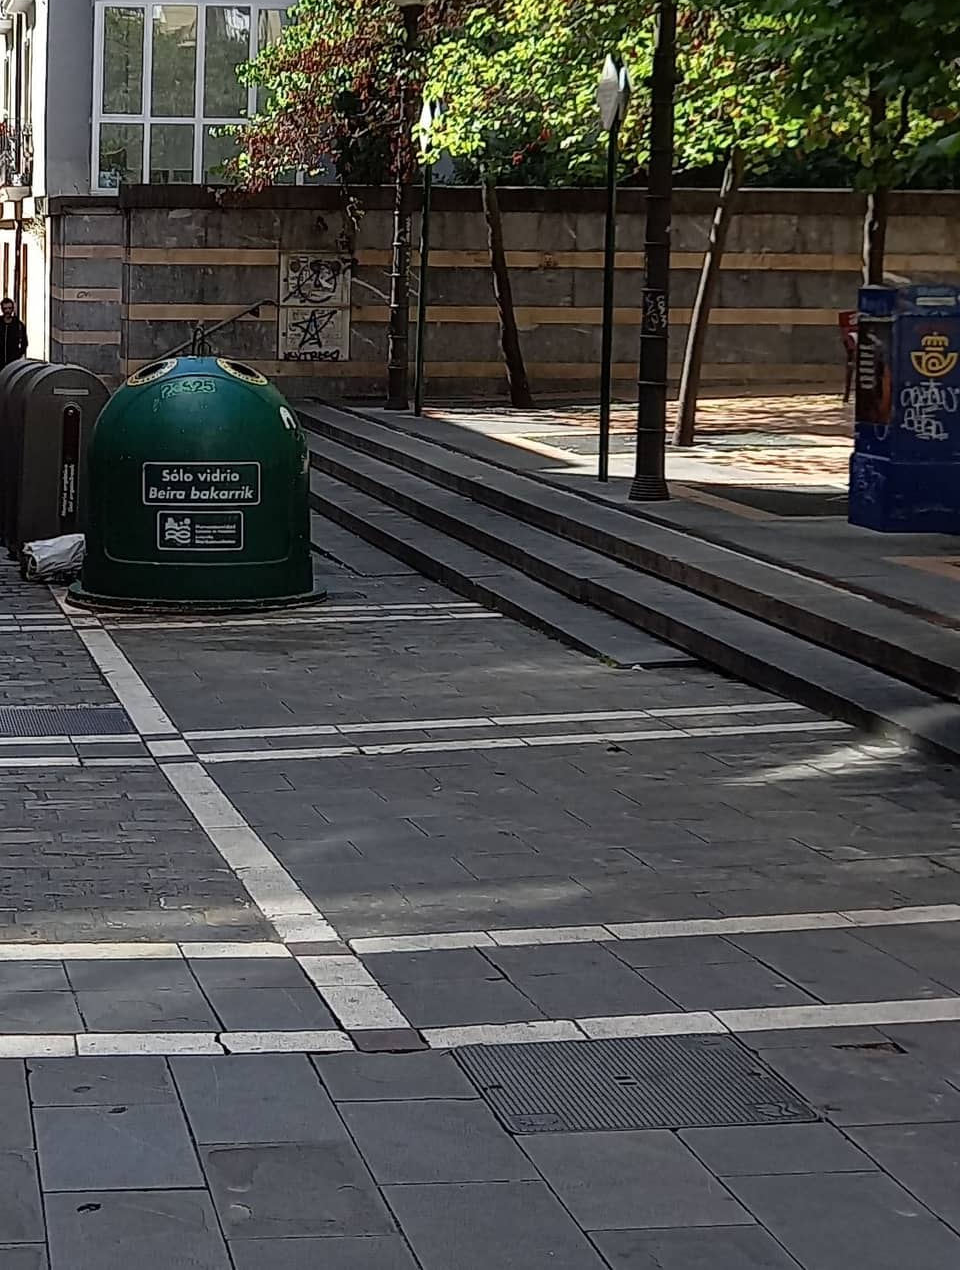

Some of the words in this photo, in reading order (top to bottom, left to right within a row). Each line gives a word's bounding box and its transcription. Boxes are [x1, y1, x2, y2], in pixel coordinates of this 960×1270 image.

[161, 468, 194, 482] Sólo
[198, 468, 240, 482] vidrio
[148, 485, 186, 500] Beira
[190, 486, 254, 500] bakarrik
